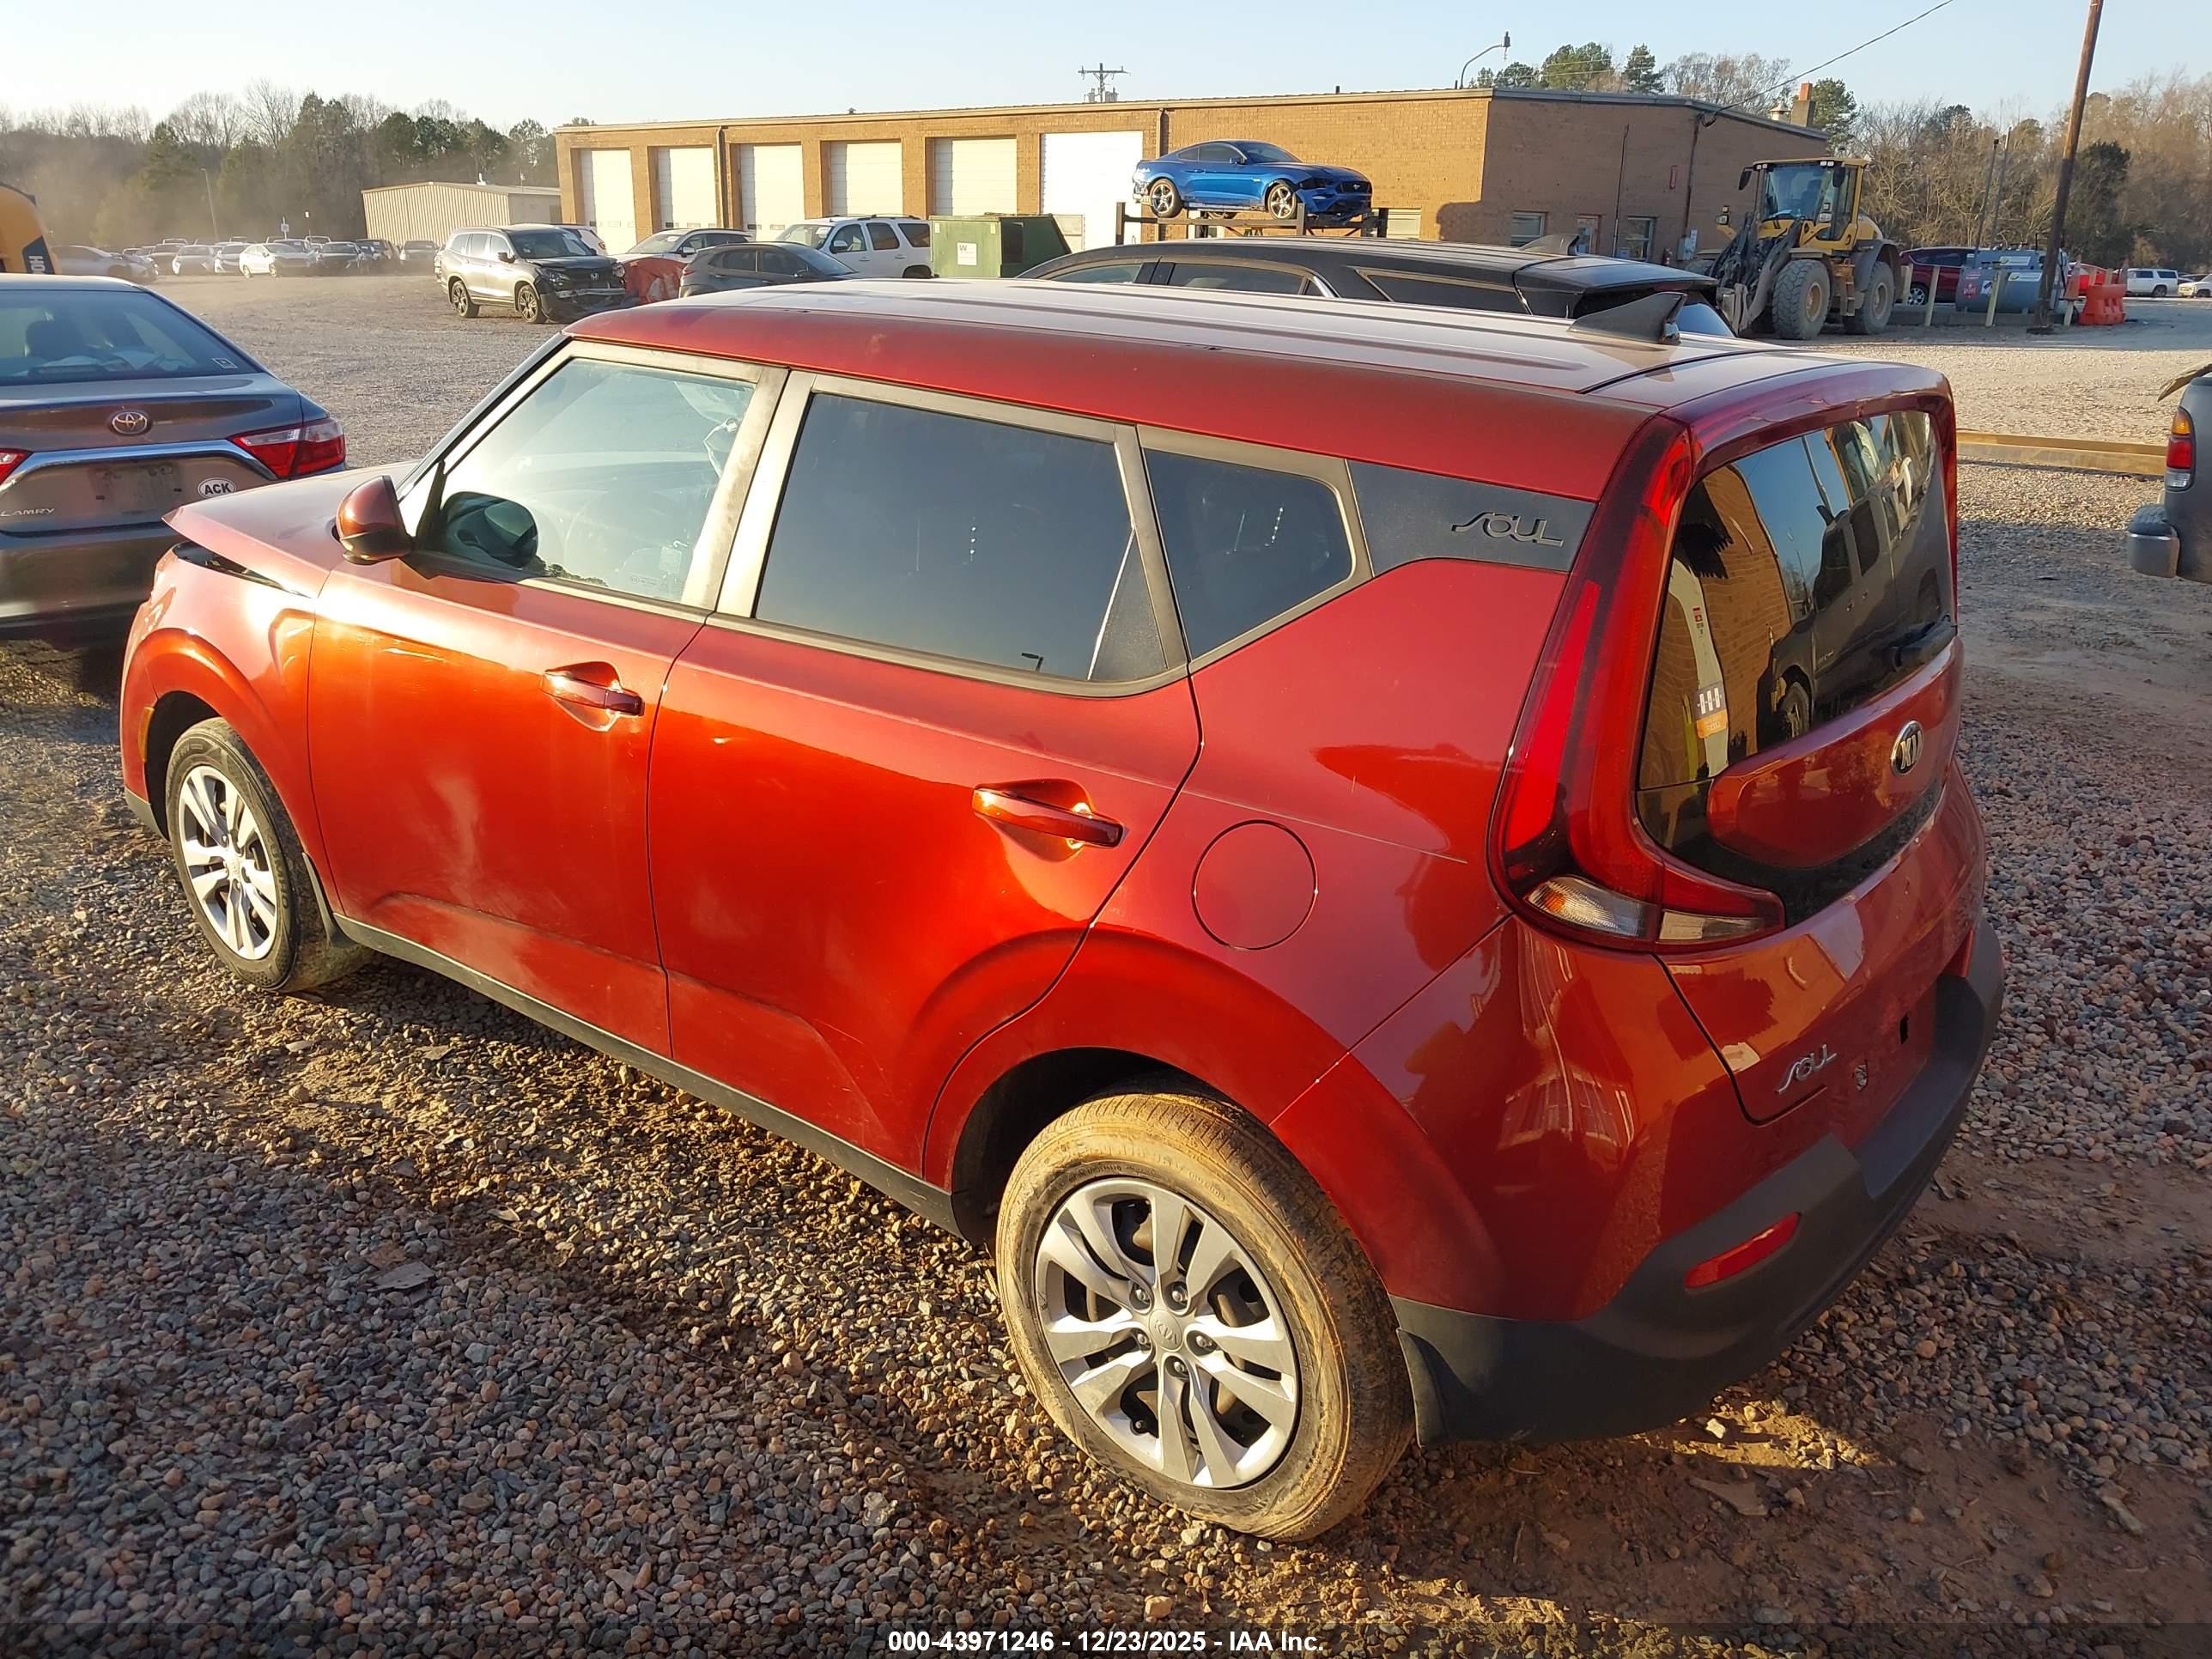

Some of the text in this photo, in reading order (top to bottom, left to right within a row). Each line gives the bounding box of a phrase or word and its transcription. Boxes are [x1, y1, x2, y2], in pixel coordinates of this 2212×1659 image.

[204, 483, 232, 495] ACK
[1450, 512, 1565, 548] SOUL
[1775, 1043, 1838, 1095] SOUL
